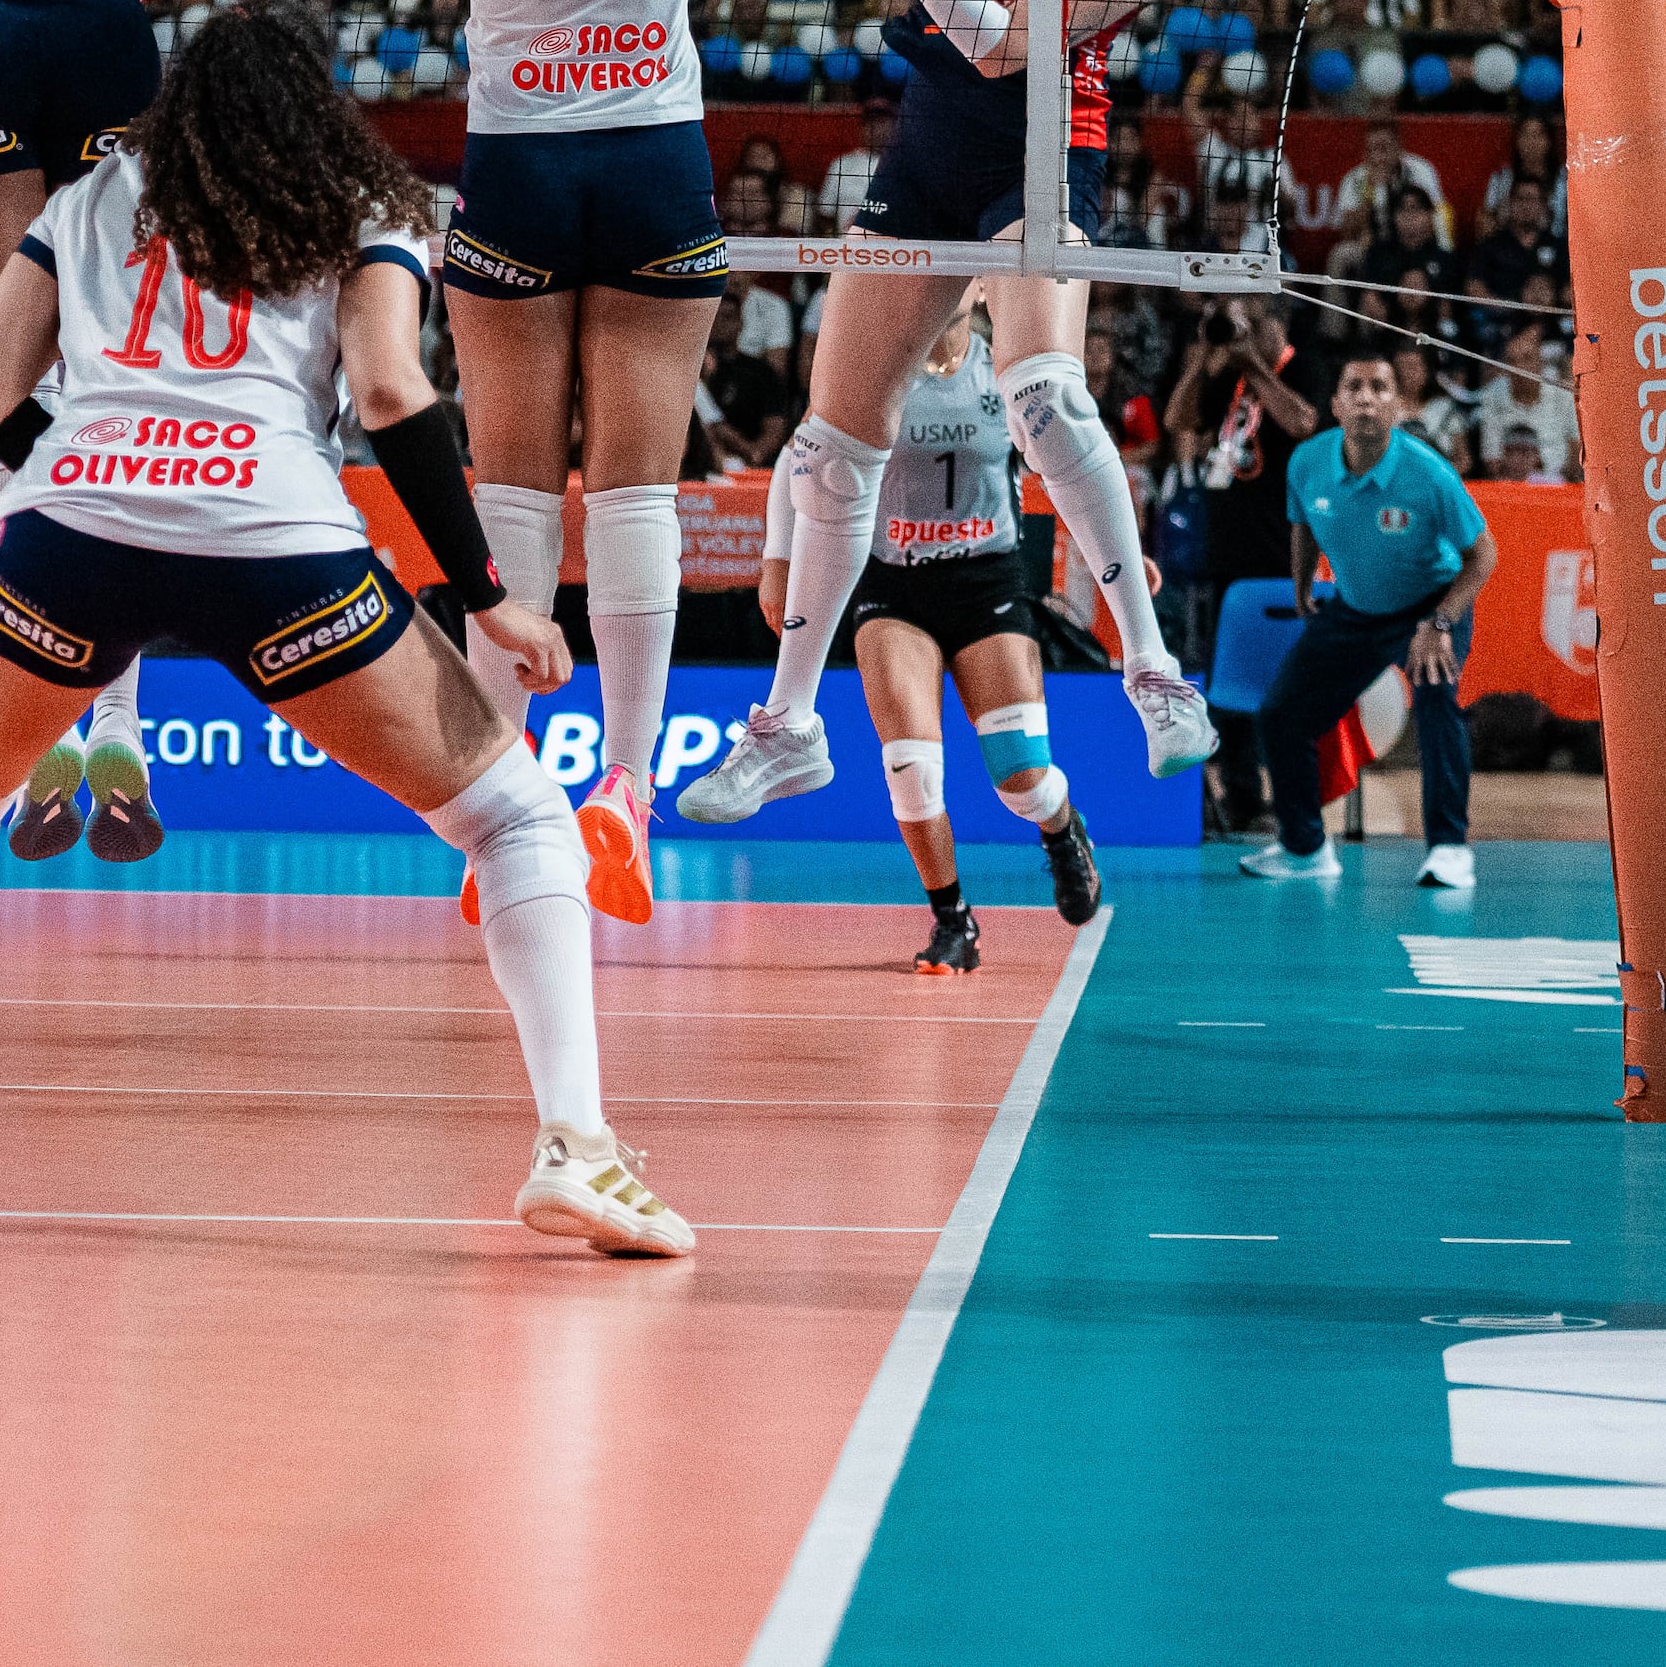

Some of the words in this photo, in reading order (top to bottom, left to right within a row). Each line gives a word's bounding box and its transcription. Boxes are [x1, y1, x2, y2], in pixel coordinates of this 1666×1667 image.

[577, 21, 668, 56] SACO
[511, 54, 671, 94] OLIVEROS
[798, 243, 931, 267] betsson
[101, 234, 253, 370] 10
[133, 417, 256, 451] SACO
[910, 423, 977, 444] USMP
[50, 454, 259, 489] OLIVEROS
[935, 451, 957, 510] 1
[888, 518, 994, 547] apuesta
[277, 588, 344, 627] PINTURAS
[261, 593, 380, 671] Ceresita
[540, 712, 733, 790] BP
